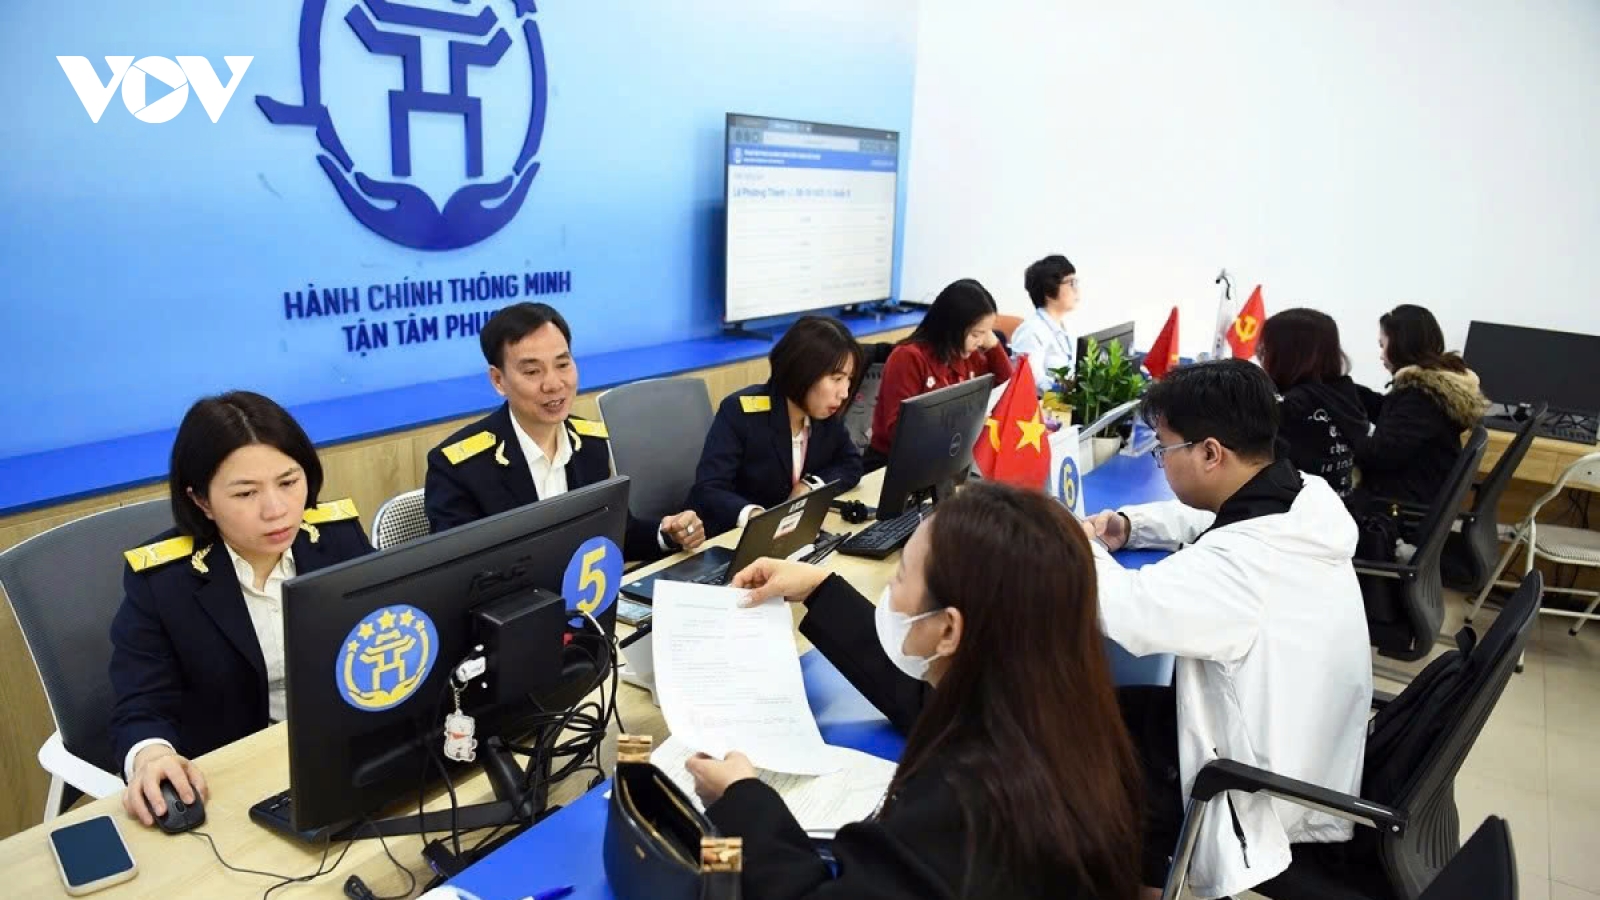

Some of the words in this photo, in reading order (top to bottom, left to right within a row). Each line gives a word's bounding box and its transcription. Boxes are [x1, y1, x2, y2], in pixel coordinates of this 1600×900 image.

[283, 283, 360, 320] HÀNH
[367, 276, 443, 311] CHÍNH
[448, 271, 519, 303] THÔNG
[524, 270, 571, 296] MINH
[341, 317, 389, 357] TẬN
[393, 312, 438, 345] TÂM
[1063, 463, 1076, 508] 6
[576, 545, 606, 614] 5
